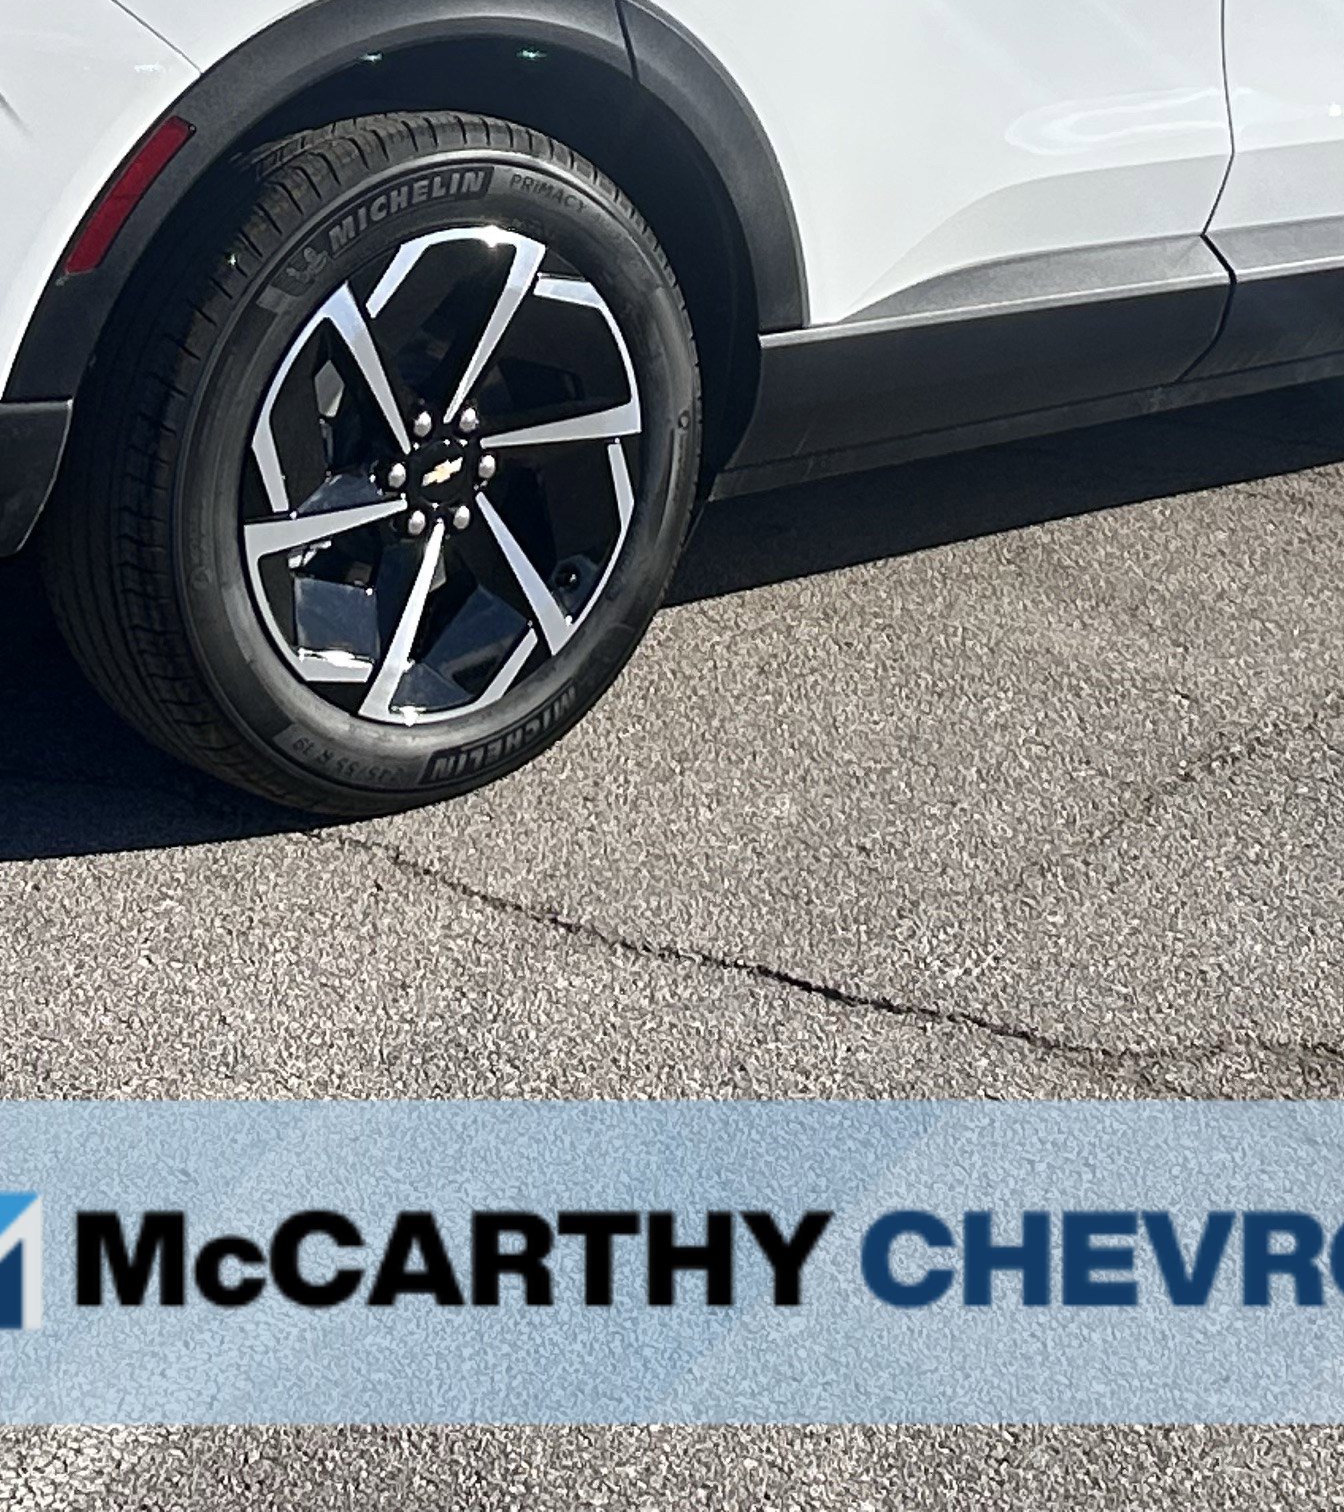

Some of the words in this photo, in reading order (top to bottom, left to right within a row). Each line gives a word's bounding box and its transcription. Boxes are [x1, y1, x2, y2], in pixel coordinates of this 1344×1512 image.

[328, 170, 486, 255] MICHELIN
[509, 173, 588, 215] PRIMACY
[431, 684, 577, 781] MICHELIN
